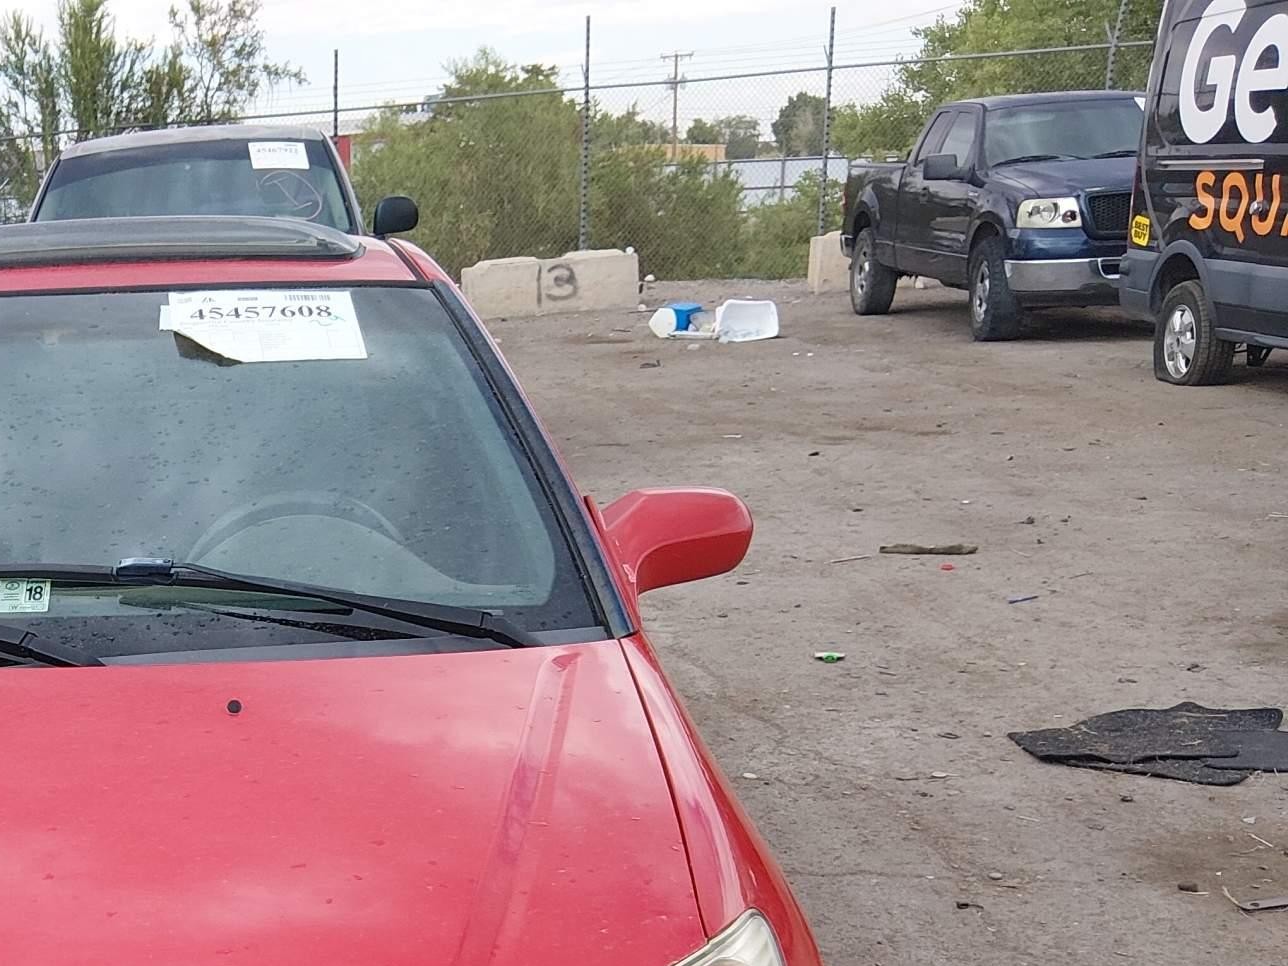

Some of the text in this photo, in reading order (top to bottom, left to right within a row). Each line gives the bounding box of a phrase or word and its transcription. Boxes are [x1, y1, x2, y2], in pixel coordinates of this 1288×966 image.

[1179, 0, 1288, 144] Ge
[1188, 171, 1288, 243] SQU
[1134, 220, 1149, 232] BEST
[1133, 229, 1147, 241] BUY
[190, 305, 332, 320] 45457608
[26, 585, 43, 601] 18
